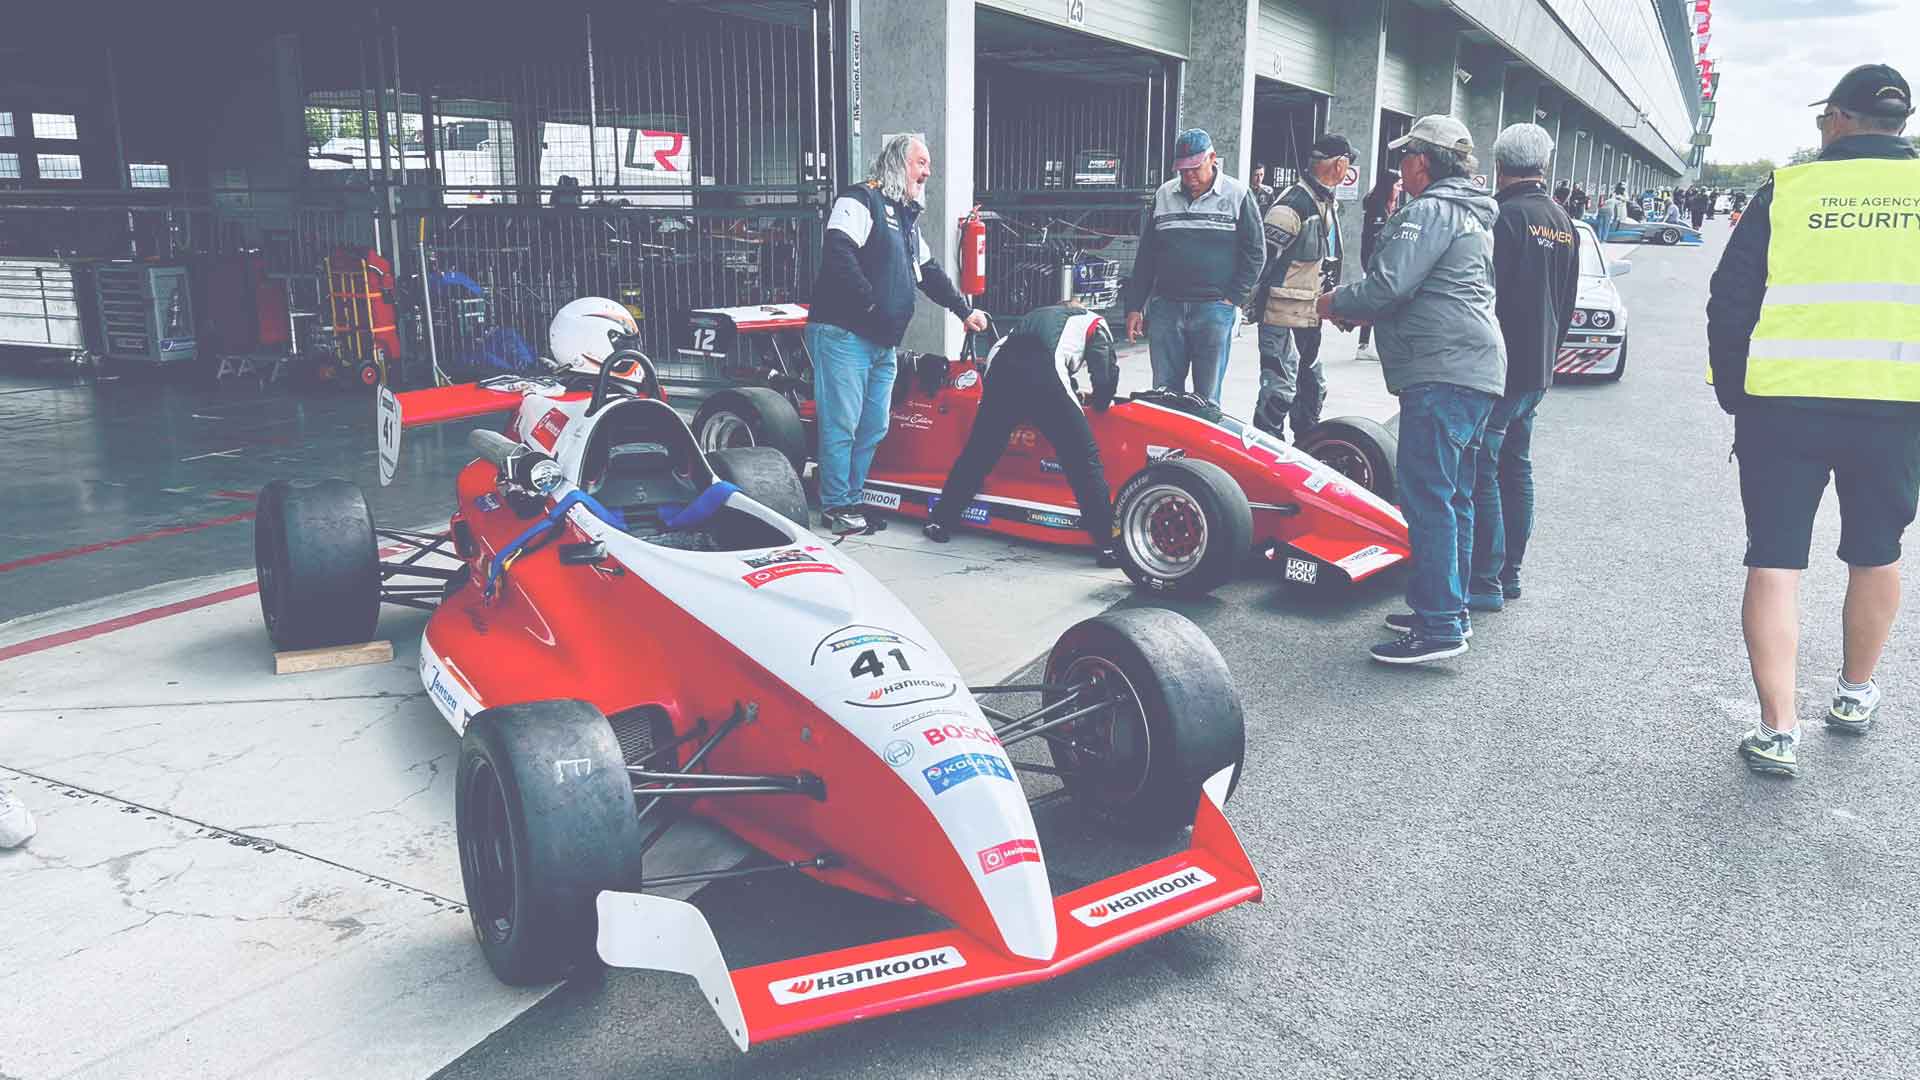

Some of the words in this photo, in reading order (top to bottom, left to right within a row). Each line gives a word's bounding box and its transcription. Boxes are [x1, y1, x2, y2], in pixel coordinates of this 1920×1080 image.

[1820, 197, 1857, 208] TRUE
[694, 328, 716, 350] 12
[383, 416, 394, 449] 41
[1286, 568, 1316, 584] MOLY
[850, 647, 912, 678] 41
[923, 724, 1003, 747] BOSCH
